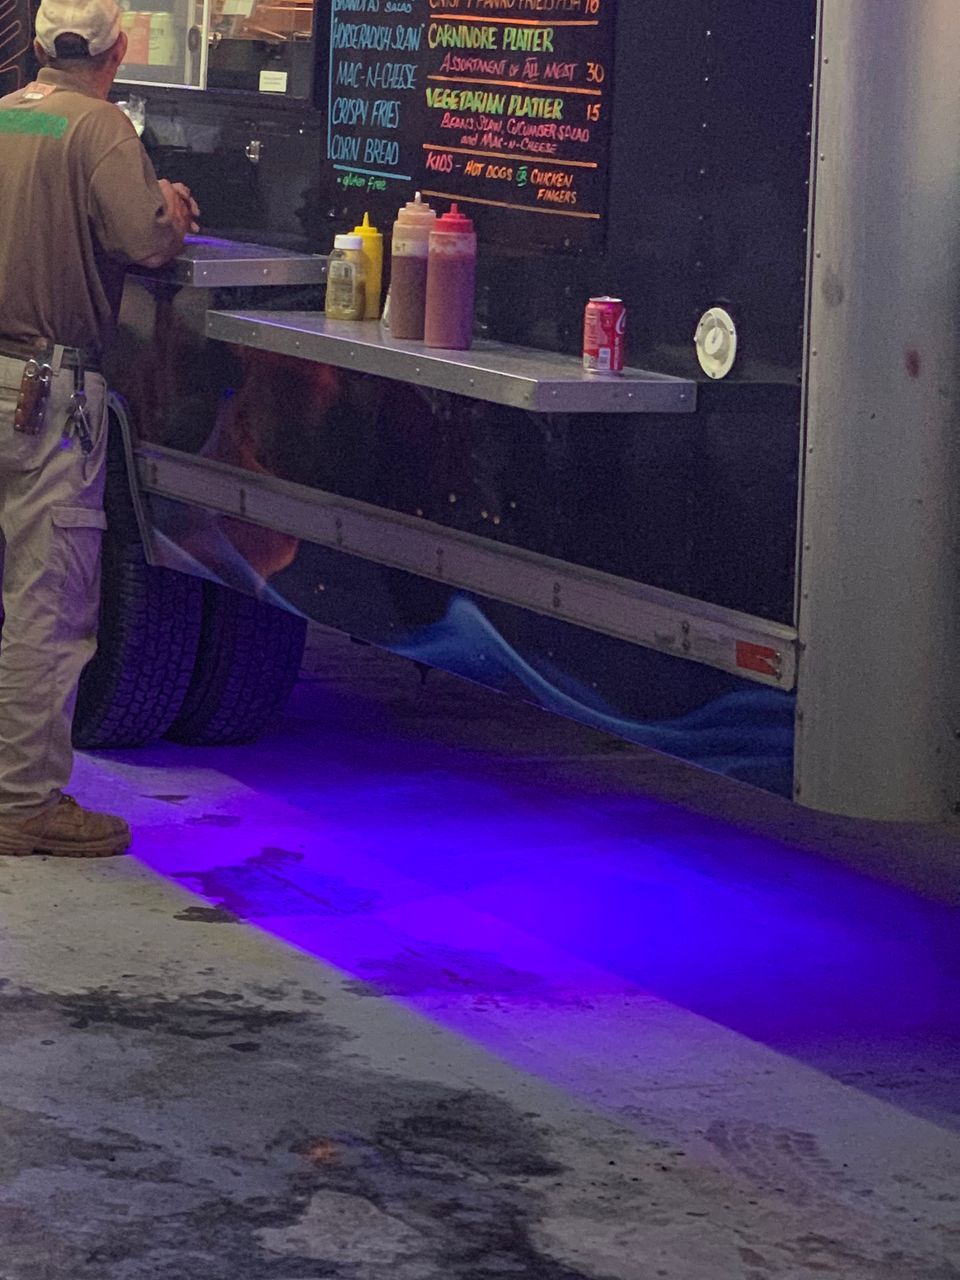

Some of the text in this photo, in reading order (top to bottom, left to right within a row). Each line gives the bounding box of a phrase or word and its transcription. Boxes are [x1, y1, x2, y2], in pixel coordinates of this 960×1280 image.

[392, 24, 422, 51] SLAW
[428, 23, 554, 52] CARNIVORE PLATTER
[586, 62, 605, 83] 30
[332, 97, 401, 128] CRISPY FRIES
[425, 87, 601, 122] VEGETARIAN PLATTER 15
[332, 135, 399, 165] CORN BREAD
[367, 176, 386, 192] free
[425, 151, 453, 172] KIDS
[464, 160, 485, 176] HOT
[485, 165, 513, 181] DOGS
[530, 169, 573, 188] CHICKEN
[537, 188, 577, 204] FINGERS
